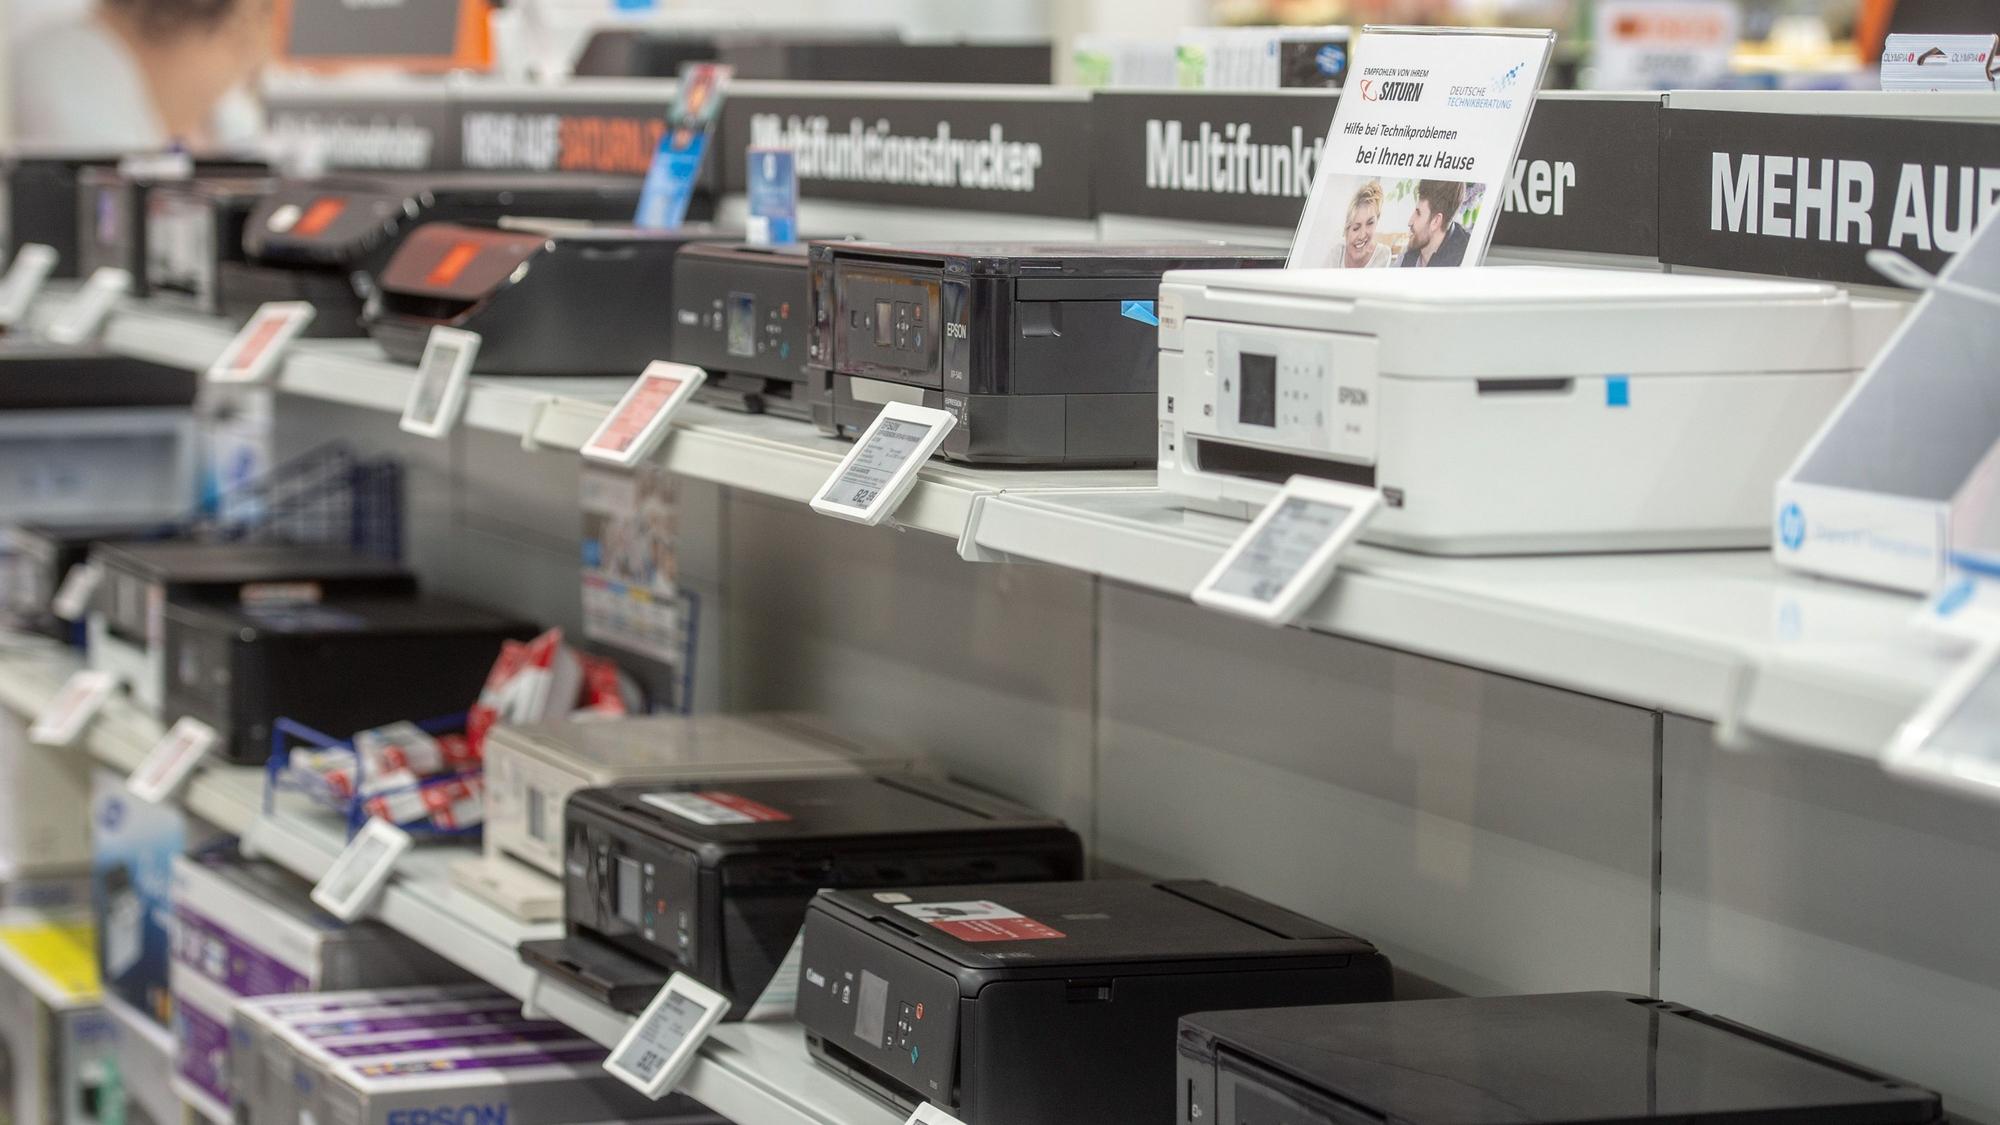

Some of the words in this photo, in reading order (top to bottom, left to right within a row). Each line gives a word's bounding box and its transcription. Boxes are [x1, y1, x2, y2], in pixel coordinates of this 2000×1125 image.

[1363, 67, 1396, 77] EMPFOHLEN
[1397, 69, 1409, 77] VON
[1410, 70, 1429, 78] IHREM
[1379, 81, 1424, 102] SATURN
[1450, 86, 1486, 97] DEUTSCHE
[1447, 97, 1512, 110] TECHNIKBERATUNG
[1344, 122, 1363, 136] Hilfe
[1365, 123, 1379, 137] bei
[1381, 124, 1458, 141] Technikproblemen
[1355, 146, 1376, 165] bei
[1378, 147, 1414, 168] Ihnen
[1416, 152, 1431, 169] zu
[1434, 151, 1475, 171] Hause
[1710, 151, 1875, 246] MEHR
[947, 322, 967, 339] EPSON
[387, 1104, 509, 1125] EPSON
